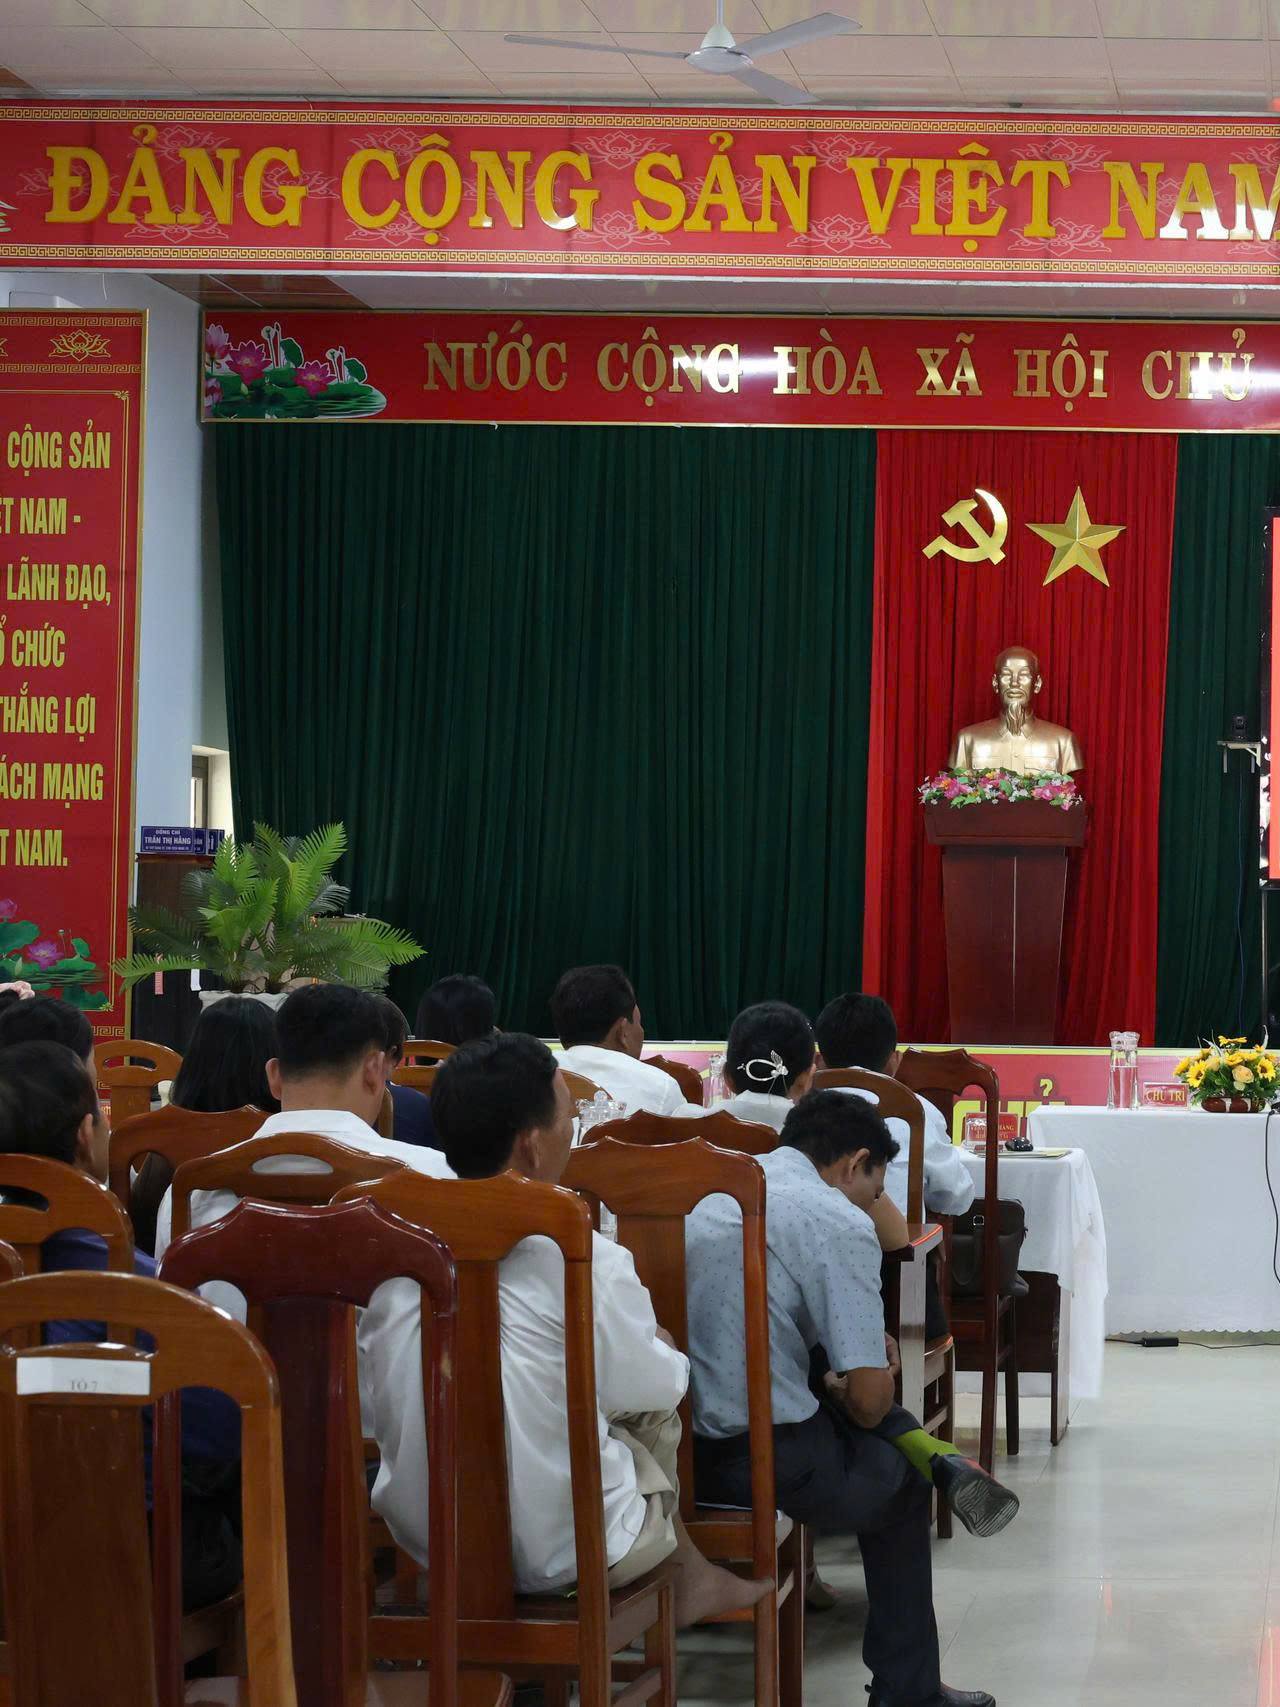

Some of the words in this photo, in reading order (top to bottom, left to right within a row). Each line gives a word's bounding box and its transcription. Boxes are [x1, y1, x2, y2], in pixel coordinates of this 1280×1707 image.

[46, 125, 309, 228] ĐẢNG
[342, 134, 601, 246] CỘNG
[633, 130, 818, 234] SẢN
[845, 143, 1071, 254] VIỆT
[424, 320, 567, 391] NƯỚC
[598, 326, 742, 408] CỘNG
[772, 328, 882, 397] HÒA
[917, 335, 982, 395] XÃ
[1014, 334, 1108, 412] HỘI
[1141, 328, 1256, 402] CHỦ
[8, 424, 62, 476] CỘNG
[69, 419, 110, 468] SẢN
[20, 498, 66, 534] NAM
[7, 557, 59, 600] LÃNH
[66, 564, 110, 609] ĐẠO,
[12, 623, 65, 667] CHỨC
[65, 694, 95, 742] LỢI
[43, 763, 103, 808] MẠNG
[16, 830, 67, 866] NAM.
